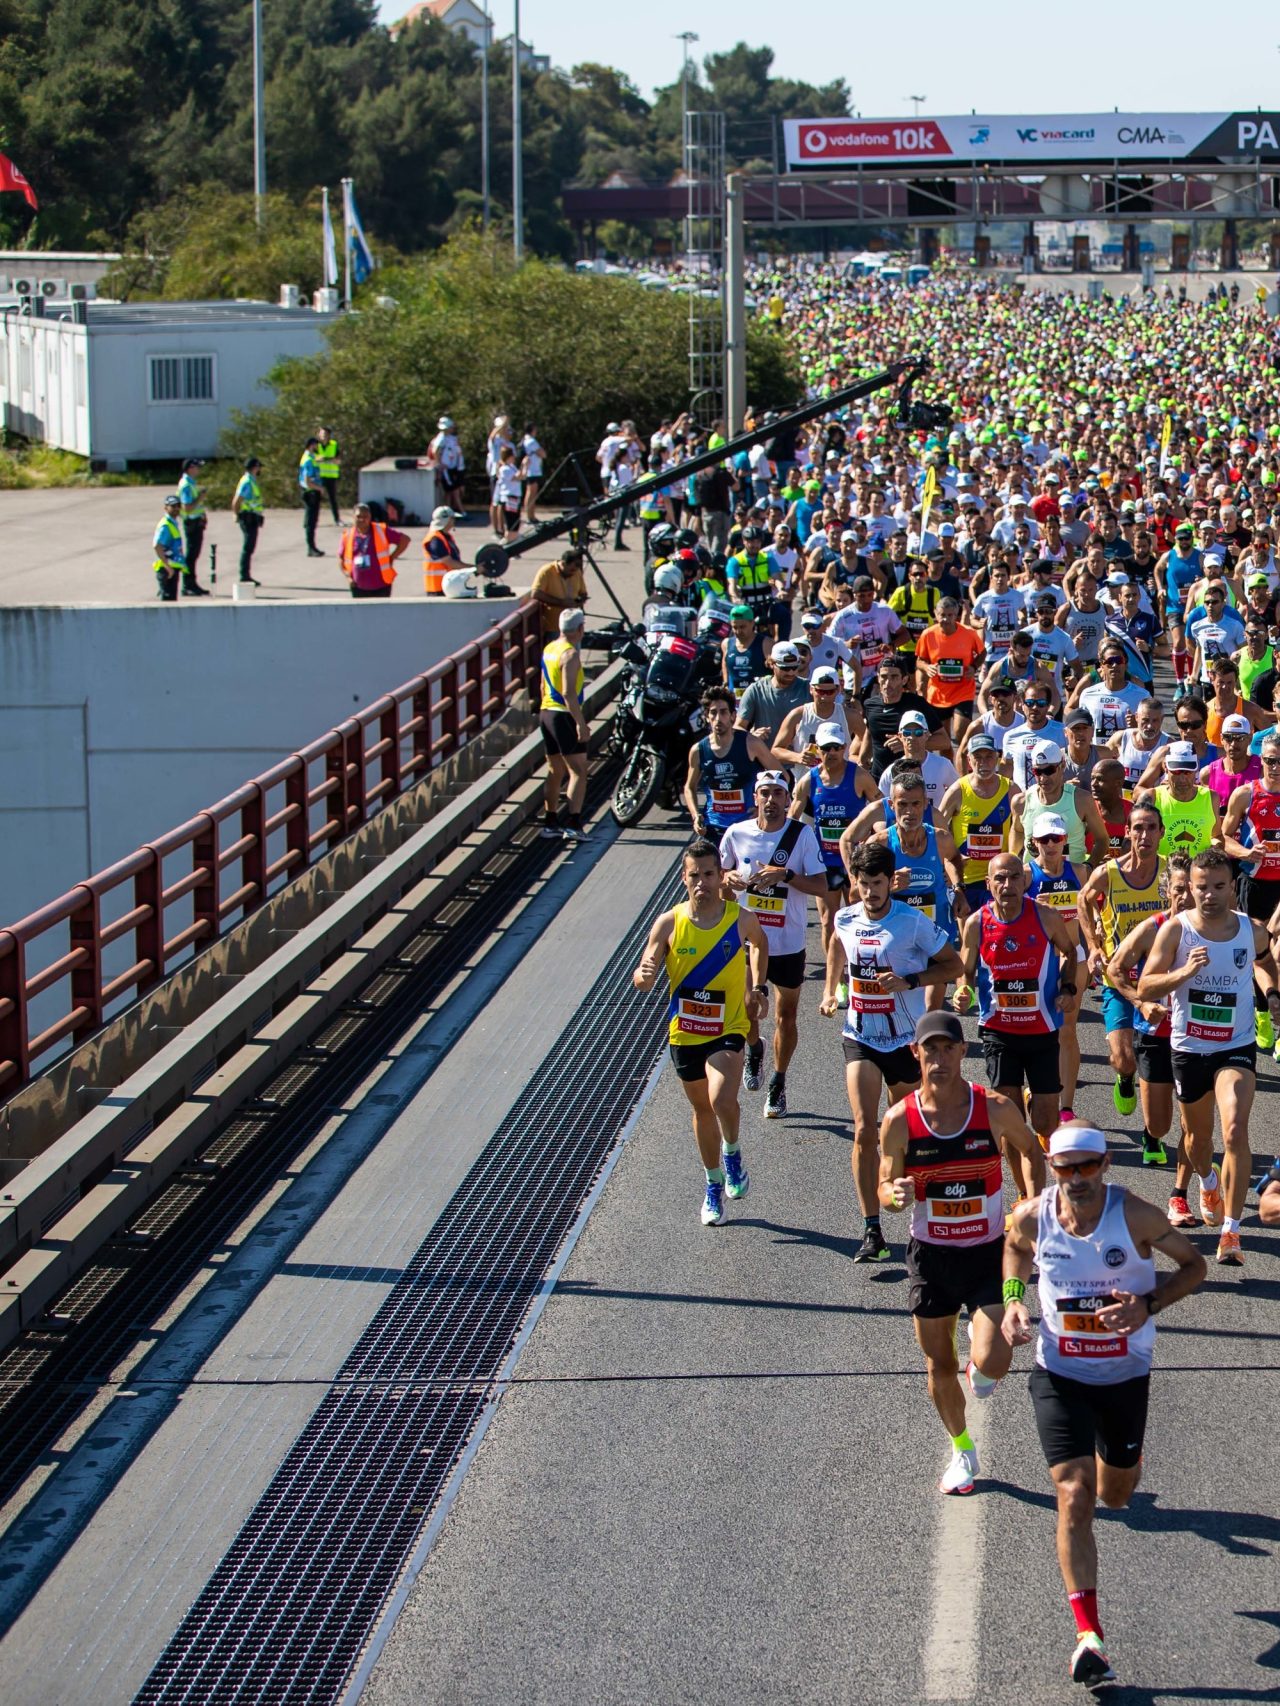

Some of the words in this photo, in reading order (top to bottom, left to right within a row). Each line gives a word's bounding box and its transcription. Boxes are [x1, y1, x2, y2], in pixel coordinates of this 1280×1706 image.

[829, 132, 889, 146] vodafone
[892, 128, 936, 150] 10k
[1016, 128, 1038, 144] VC
[1041, 128, 1095, 139] viacard
[1117, 128, 1166, 144] CMA
[719, 781, 732, 790] edp
[718, 791, 736, 800] 361
[828, 818, 841, 827] edp
[979, 824, 993, 834] edp
[976, 836, 994, 845] 322
[1053, 880, 1068, 890] edp
[756, 899, 775, 910] 211
[907, 896, 923, 905] edp
[1052, 894, 1072, 905] 244
[860, 966, 877, 978] edp
[1194, 974, 1239, 986] SAMBA
[859, 983, 880, 994] 360
[1008, 980, 1024, 992] edp
[694, 989, 711, 1002] edp
[1006, 995, 1028, 1007] 306
[1204, 993, 1222, 1005] edp
[690, 1004, 712, 1017] 323
[1200, 1009, 1223, 1020] 107
[694, 1024, 719, 1032] SEASIDE
[1203, 1029, 1229, 1038] SEASIDE
[944, 1183, 967, 1197] edp
[943, 1202, 971, 1215] 370
[951, 1224, 983, 1234] SEASIDE
[1079, 1297, 1103, 1309] edp
[1084, 1343, 1121, 1352] SEASIDE
